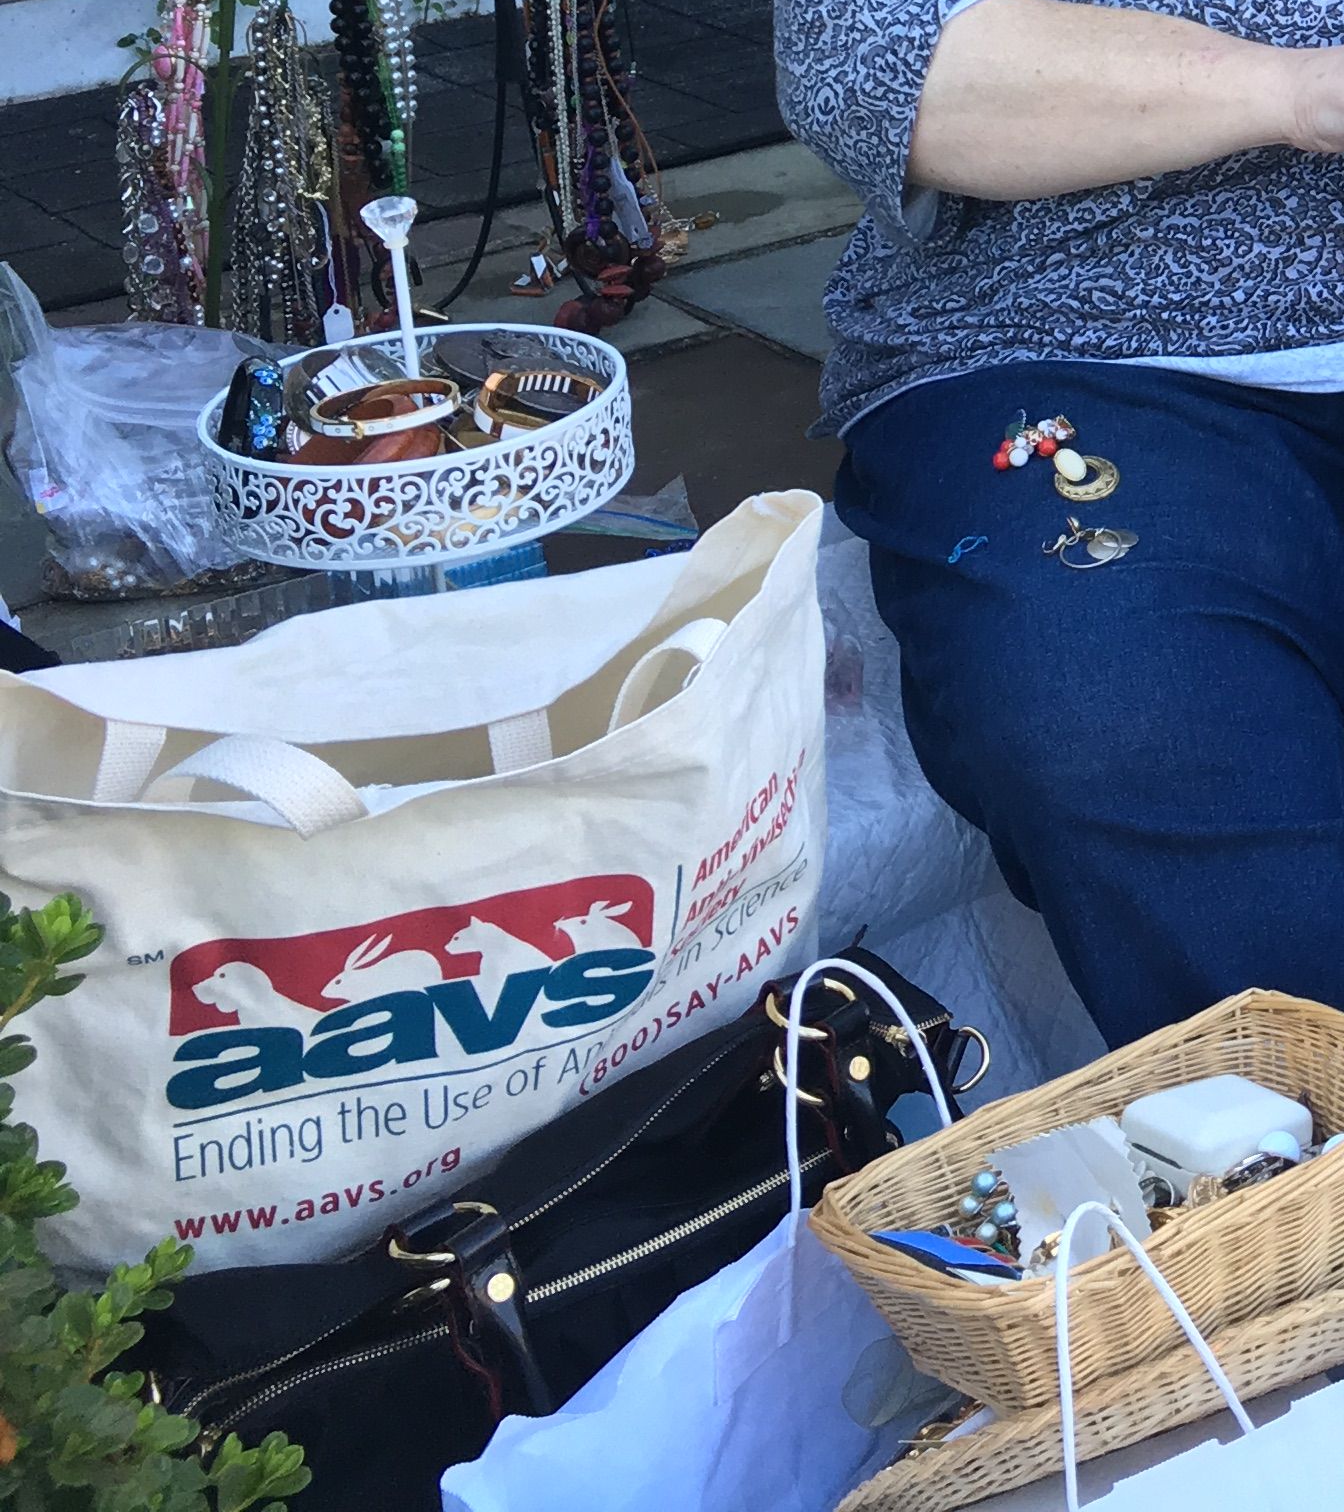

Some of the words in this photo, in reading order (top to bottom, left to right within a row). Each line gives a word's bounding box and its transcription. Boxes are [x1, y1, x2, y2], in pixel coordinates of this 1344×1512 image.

[692, 772, 778, 891] American
[127, 950, 164, 966] SM
[166, 948, 656, 1110] aavs
[173, 1115, 323, 1181] Ending
[338, 1097, 406, 1143] the
[424, 1083, 492, 1129] Use
[506, 1056, 547, 1096] of
[677, 941, 701, 976] in
[711, 858, 807, 951] science
[174, 1147, 461, 1240] www.aavs.org
